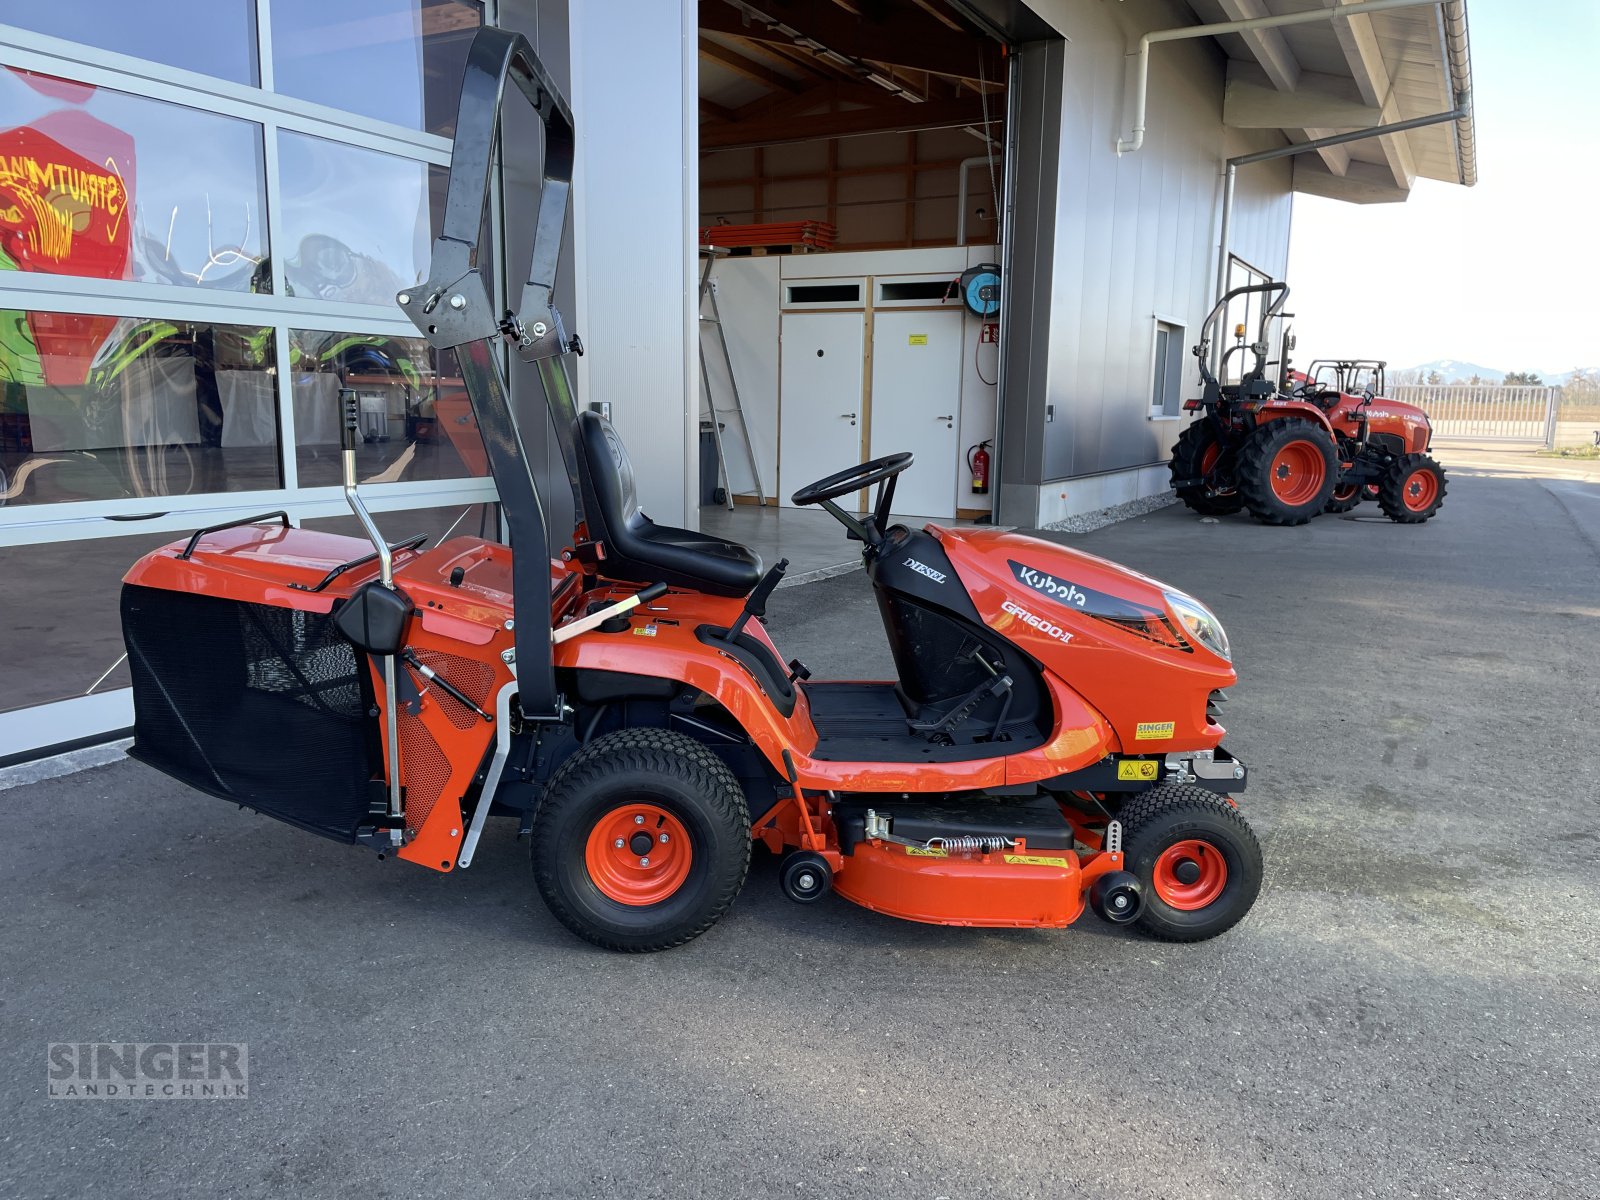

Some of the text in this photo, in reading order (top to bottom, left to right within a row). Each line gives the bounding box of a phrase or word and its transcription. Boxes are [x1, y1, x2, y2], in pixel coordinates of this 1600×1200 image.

[902, 557, 947, 584] DIESEL
[1020, 566, 1086, 607] Kubota
[1137, 722, 1173, 732] SINGER
